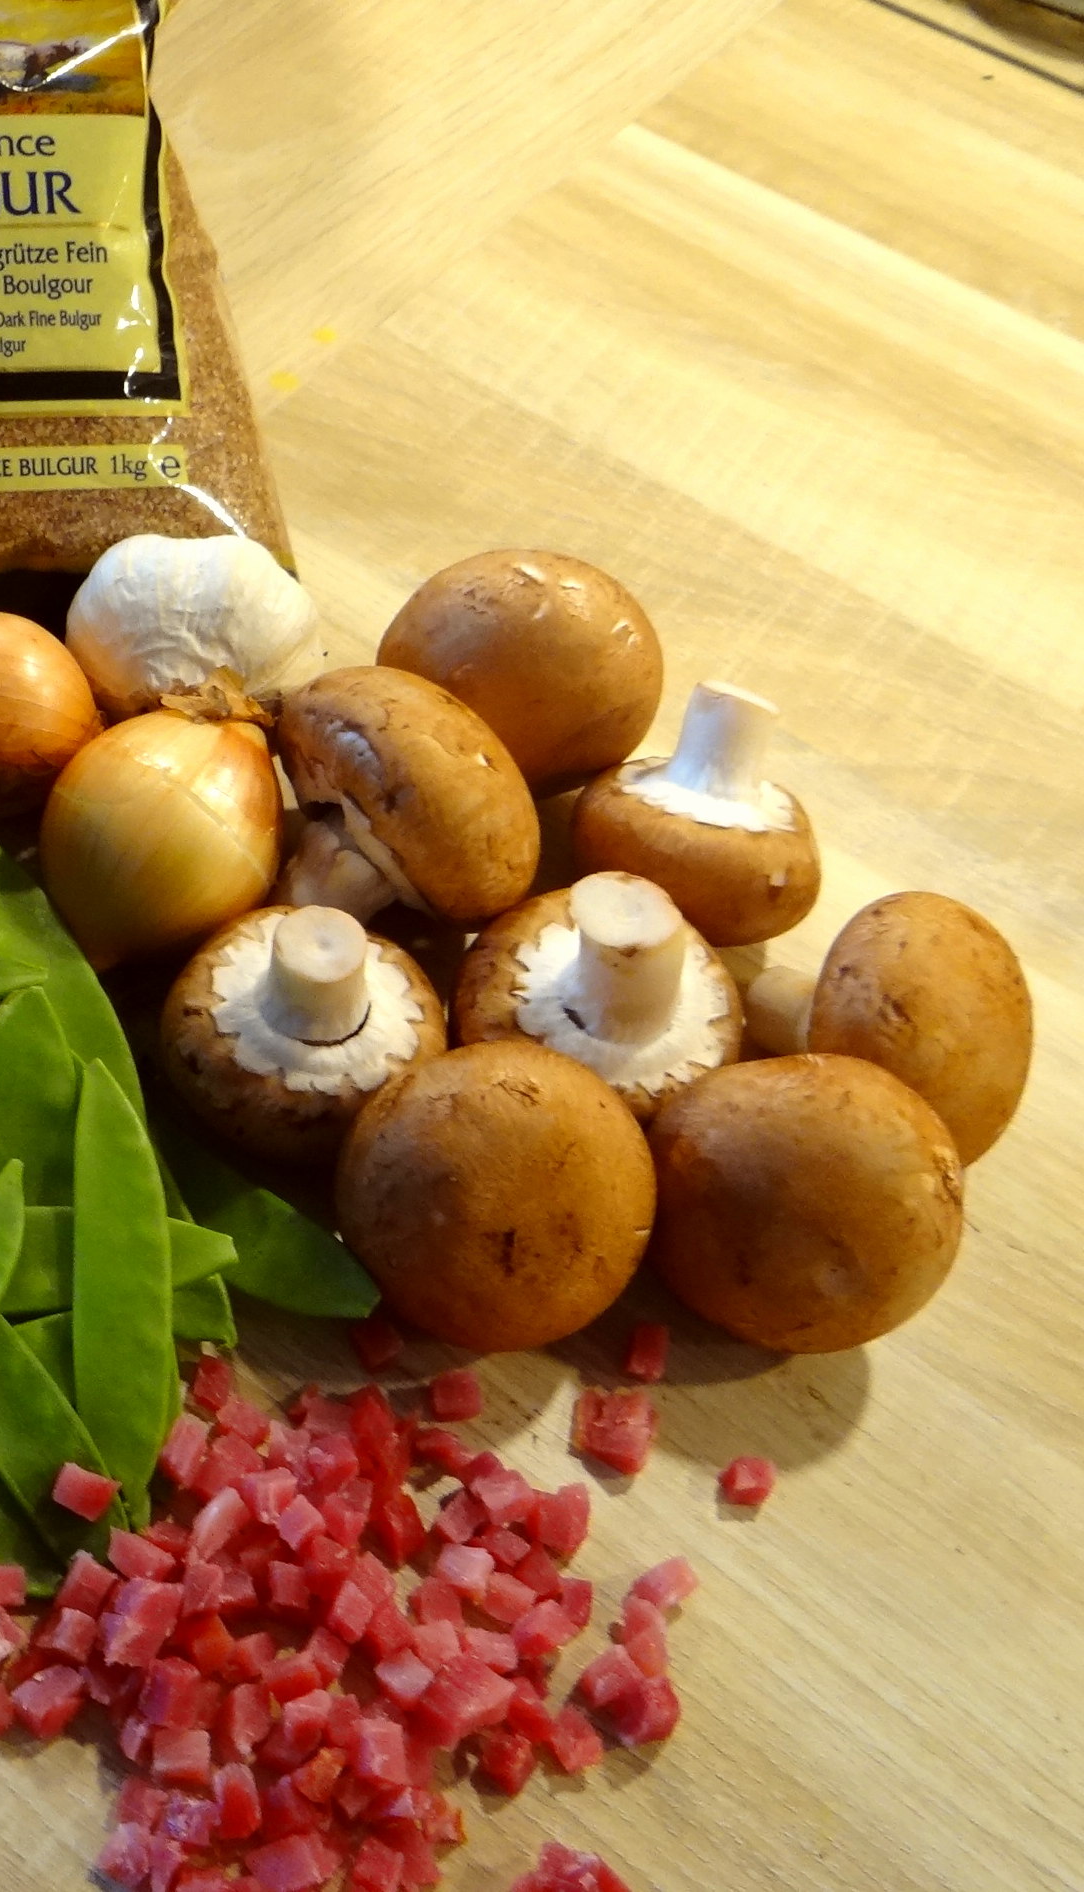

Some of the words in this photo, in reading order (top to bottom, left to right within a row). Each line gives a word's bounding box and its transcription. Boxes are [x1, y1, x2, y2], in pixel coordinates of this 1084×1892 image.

[65, 241, 108, 263] Fein
[3, 274, 93, 299] Boulgour
[29, 310, 56, 327] Fine
[60, 309, 102, 330] Bulgur
[19, 456, 98, 476] BULGUR
[111, 454, 148, 480] 1kg
